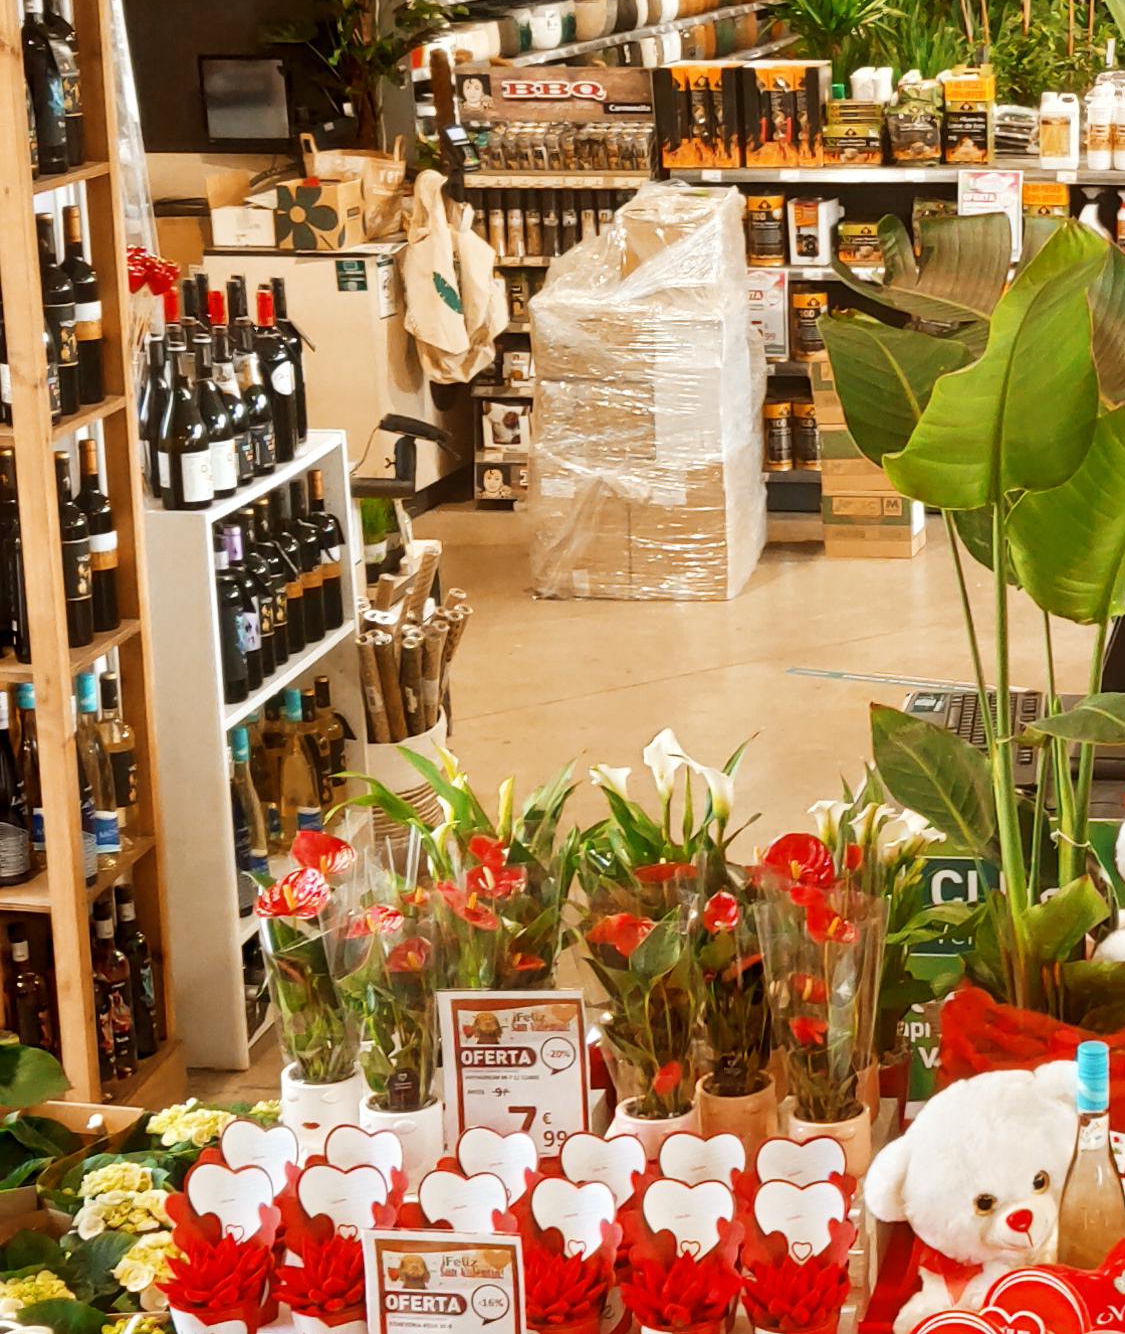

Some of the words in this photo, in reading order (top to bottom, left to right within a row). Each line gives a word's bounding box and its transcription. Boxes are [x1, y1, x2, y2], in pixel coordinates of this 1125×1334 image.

[502, 80, 607, 101] BBQ
[461, 1049, 532, 1066] OFERTA
[508, 1105, 537, 1133] 7
[542, 1112, 552, 1125] €
[543, 1130, 568, 1148] 99
[385, 1294, 462, 1314] OFERTA
